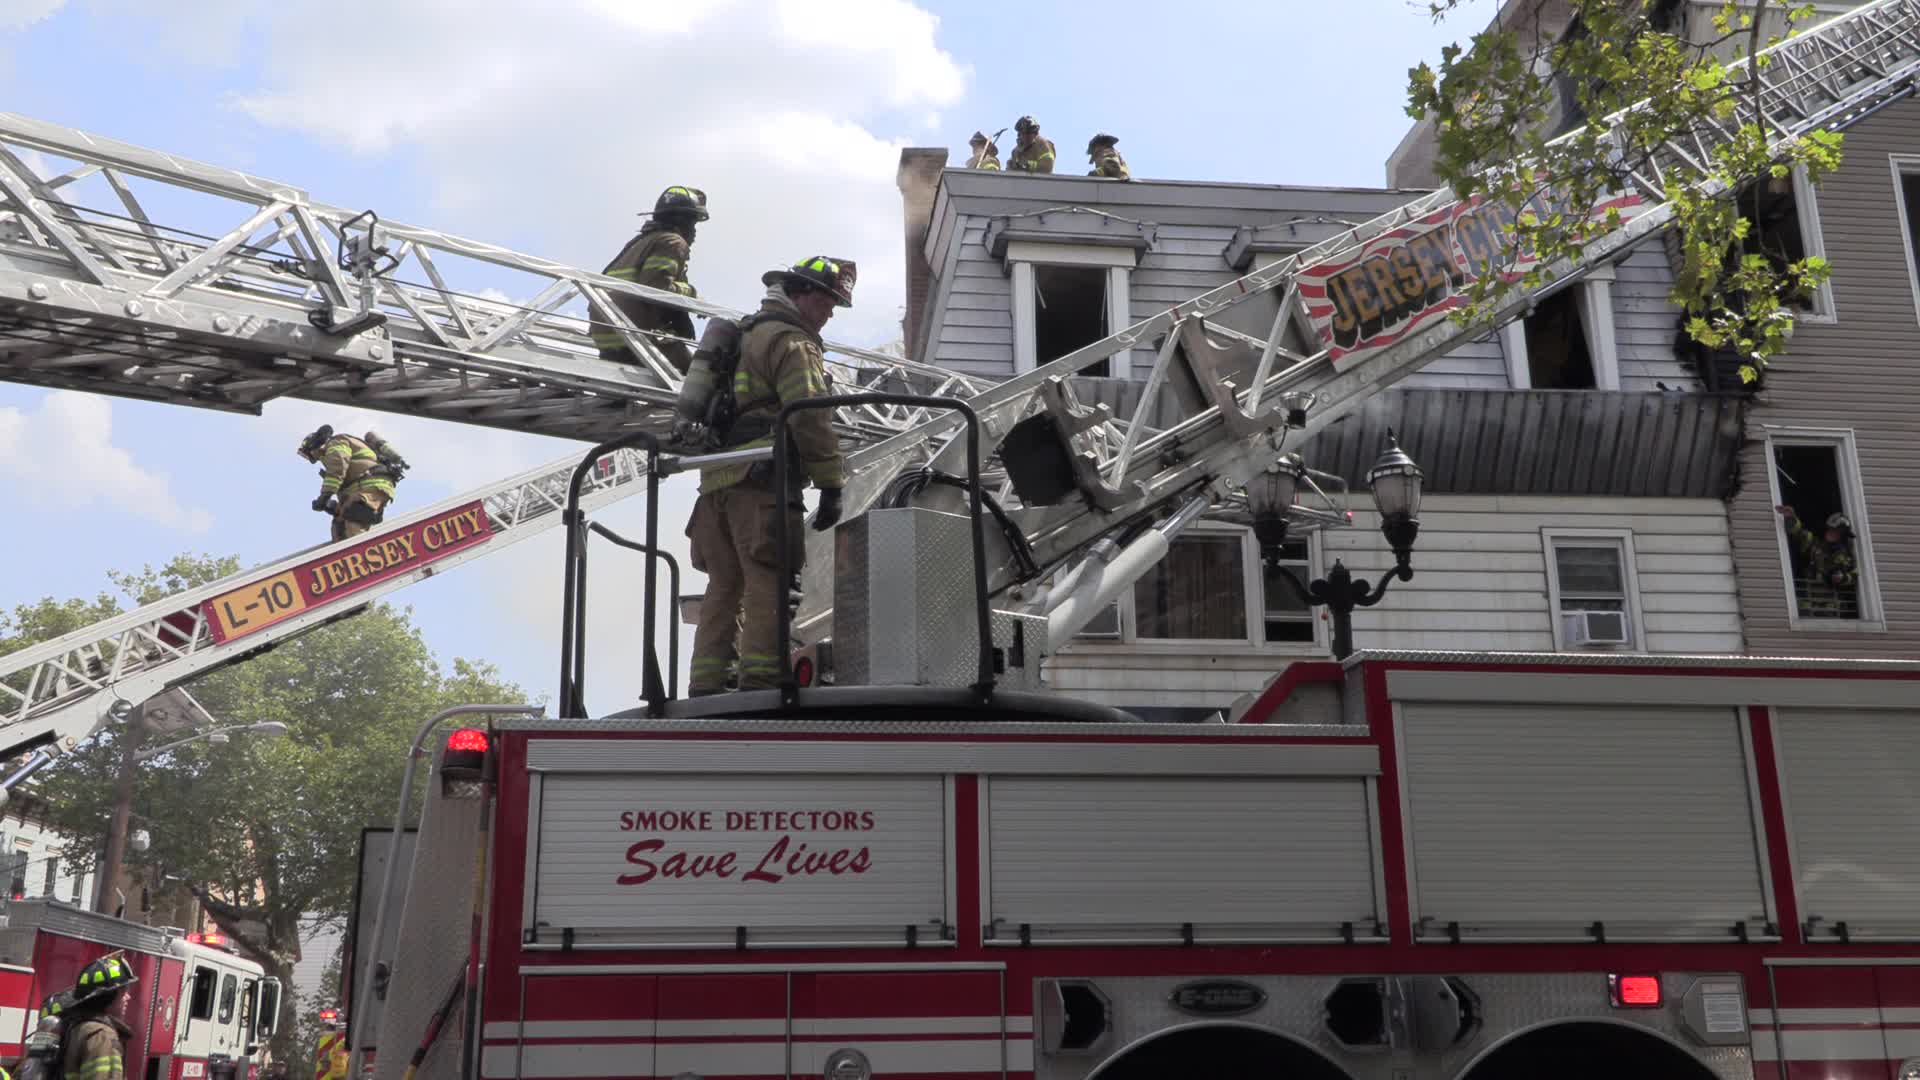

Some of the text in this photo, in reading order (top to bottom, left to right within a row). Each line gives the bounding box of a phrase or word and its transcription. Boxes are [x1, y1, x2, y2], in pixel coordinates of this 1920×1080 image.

[1328, 224, 1463, 334] JERSEY
[224, 507, 483, 629] L-10 JERSEY CITY
[616, 834, 873, 886] Save Lives
[619, 810, 875, 832] SMOKE DETECTORS
